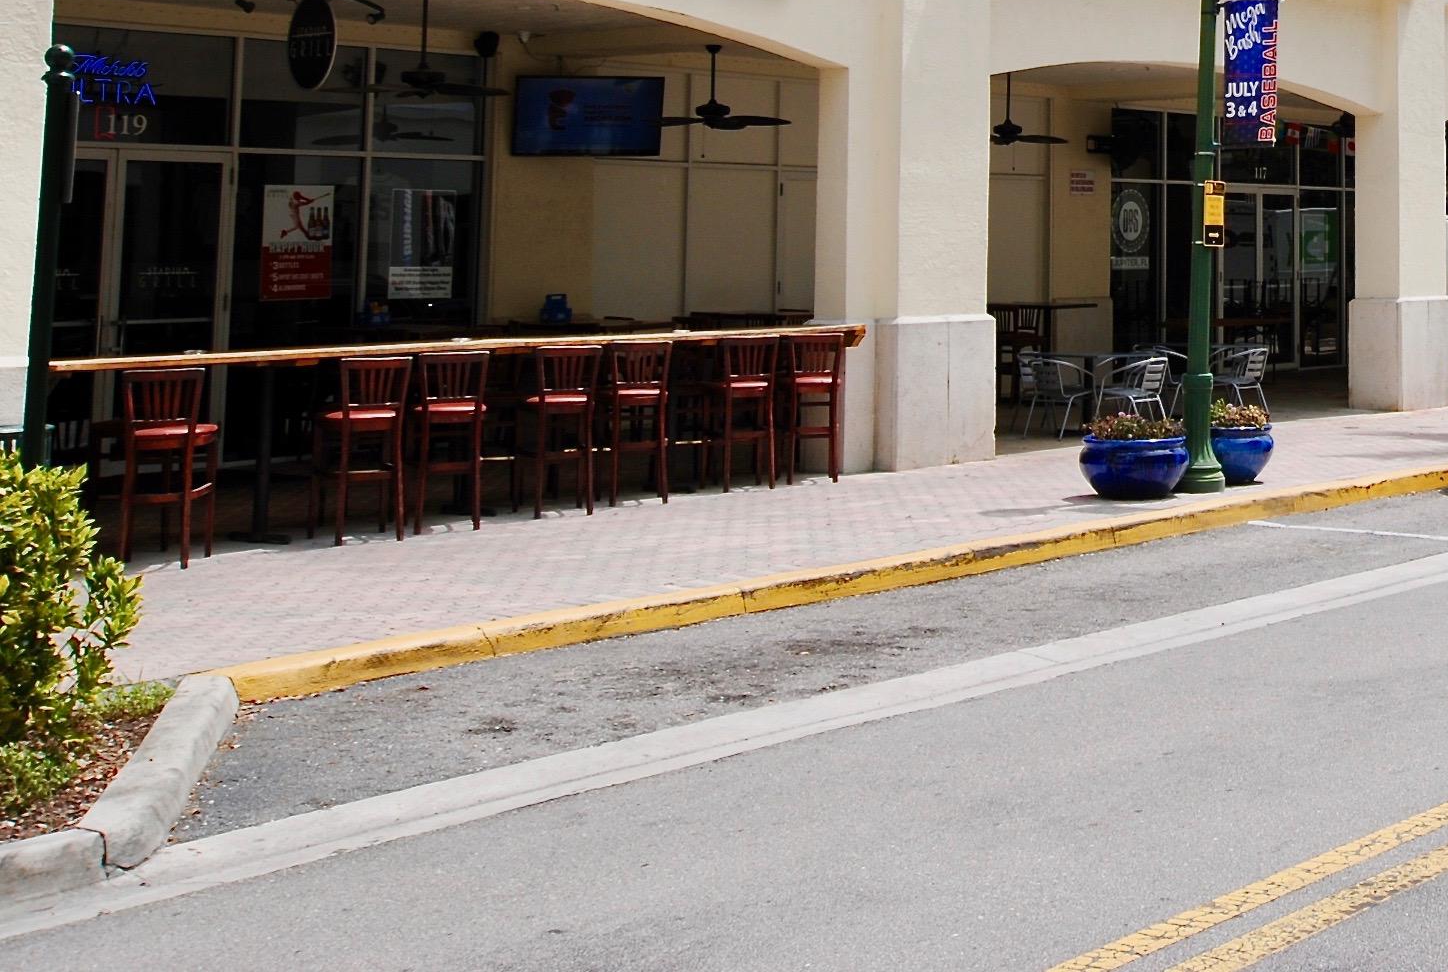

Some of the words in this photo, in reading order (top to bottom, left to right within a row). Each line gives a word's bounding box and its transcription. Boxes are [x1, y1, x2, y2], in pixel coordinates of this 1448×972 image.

[1226, 3, 1266, 34] Mega
[1226, 24, 1261, 60] Bash
[1225, 81, 1259, 98] JULY
[1258, 19, 1278, 142] BASEBALL
[108, 113, 147, 136] 119
